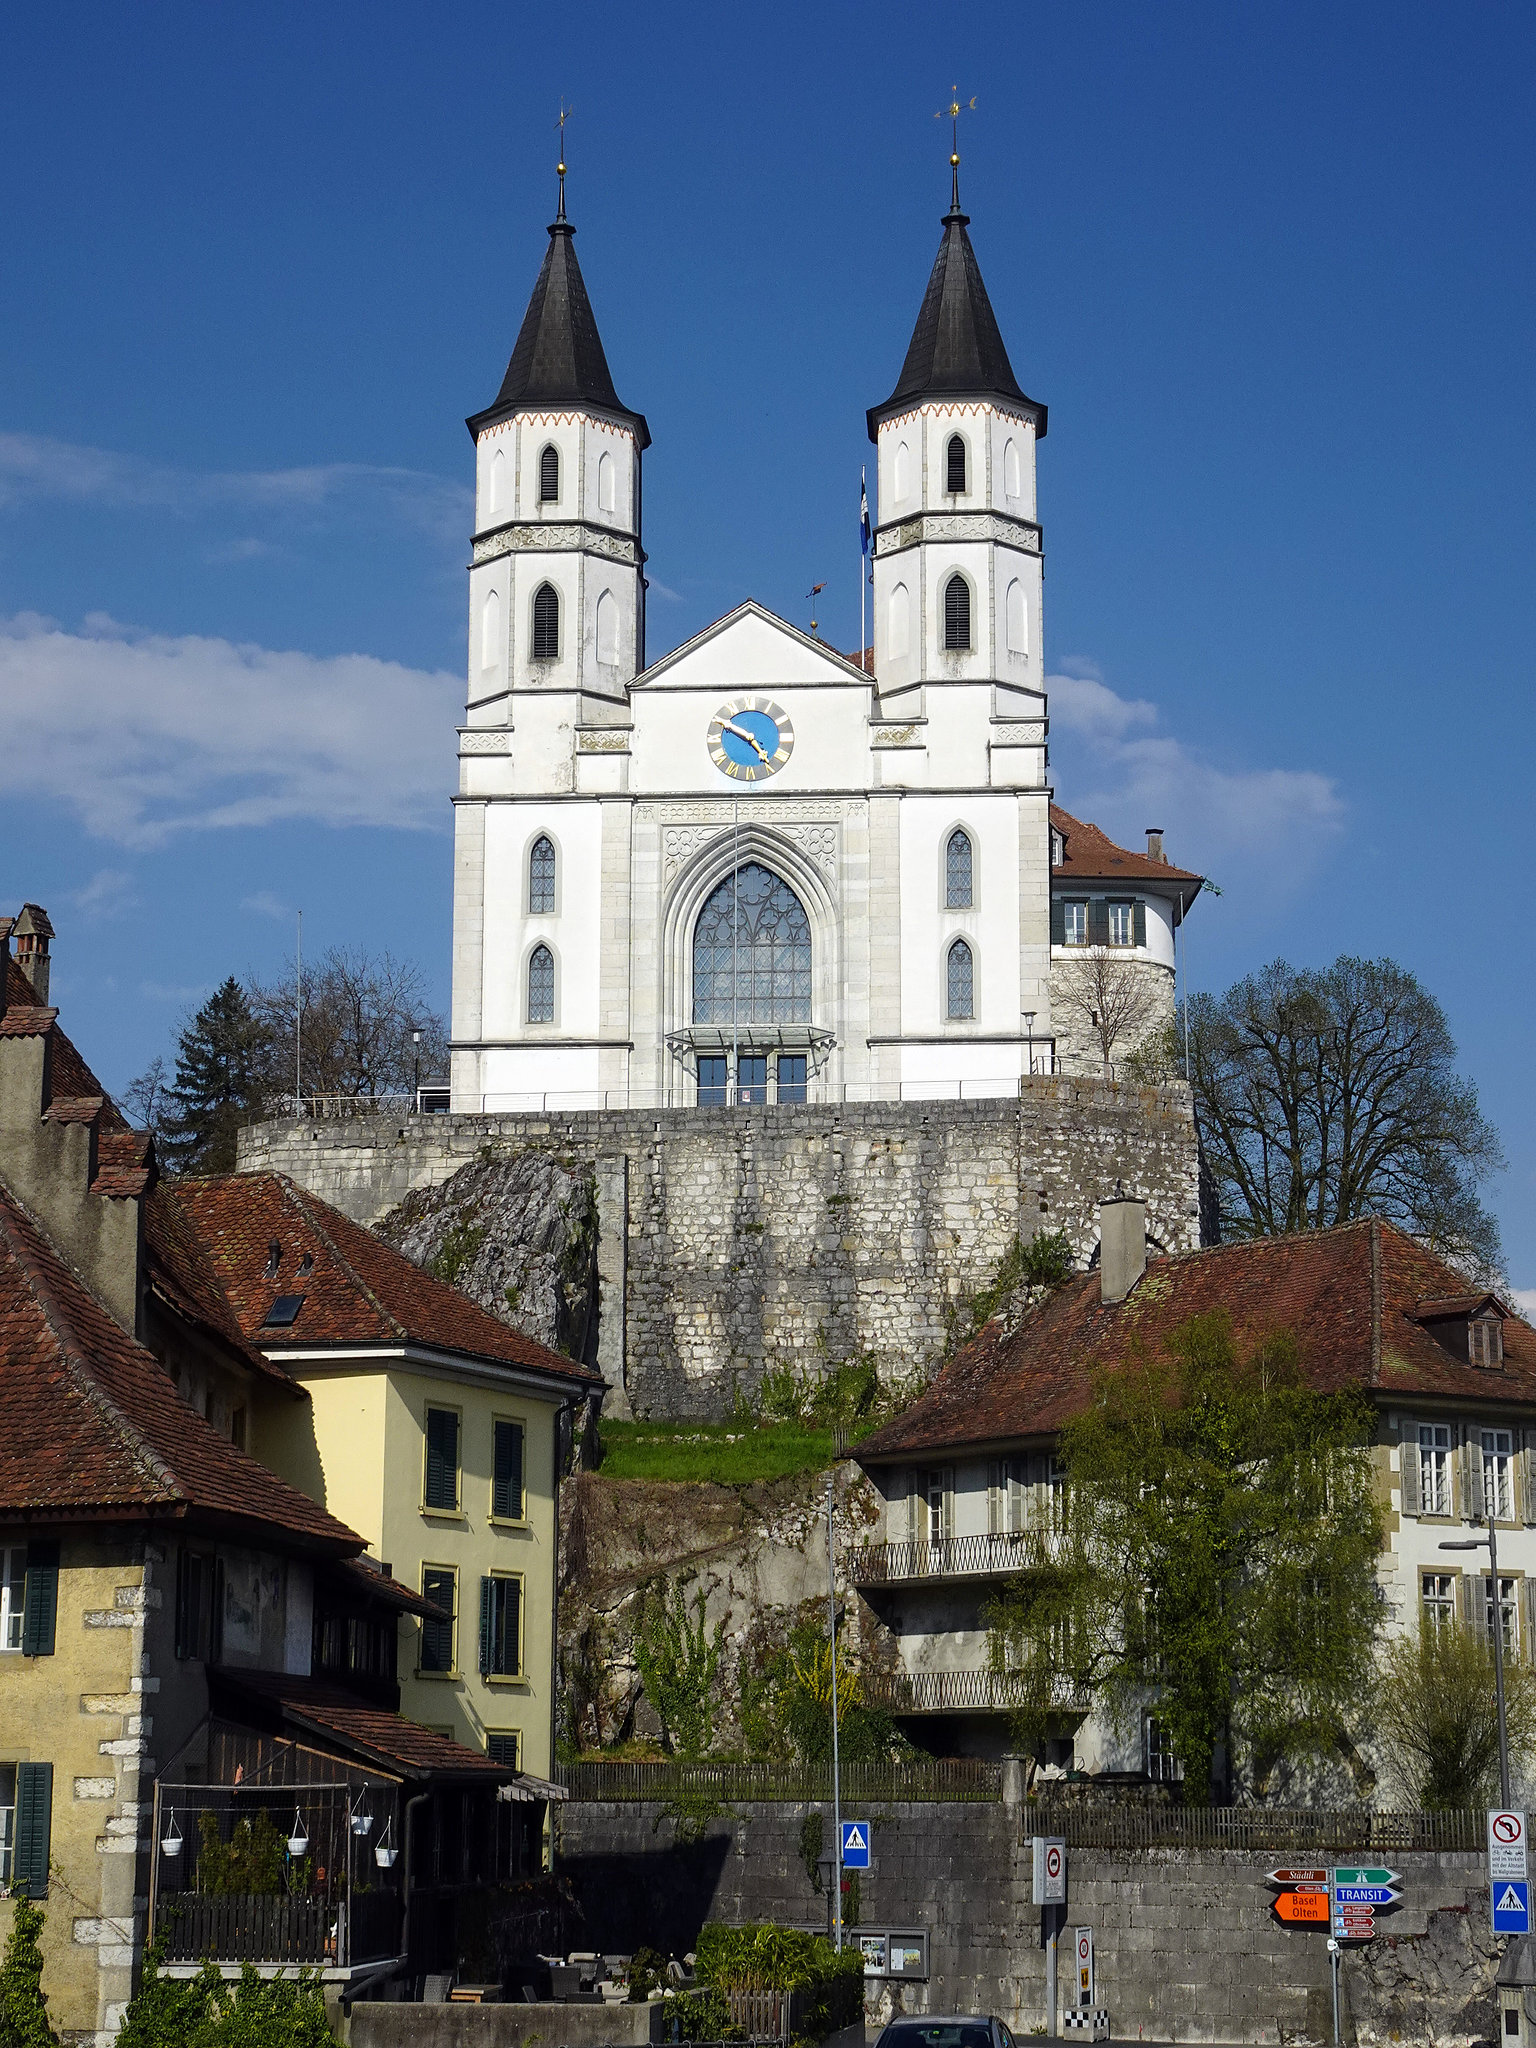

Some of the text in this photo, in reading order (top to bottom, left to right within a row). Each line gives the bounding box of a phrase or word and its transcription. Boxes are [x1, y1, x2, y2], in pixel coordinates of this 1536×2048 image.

[1289, 1870, 1315, 1880] Städtli
[1340, 1889, 1383, 1900] TRANSIT
[1292, 1895, 1317, 1905] Basel
[1292, 1908, 1318, 1918] Olten
